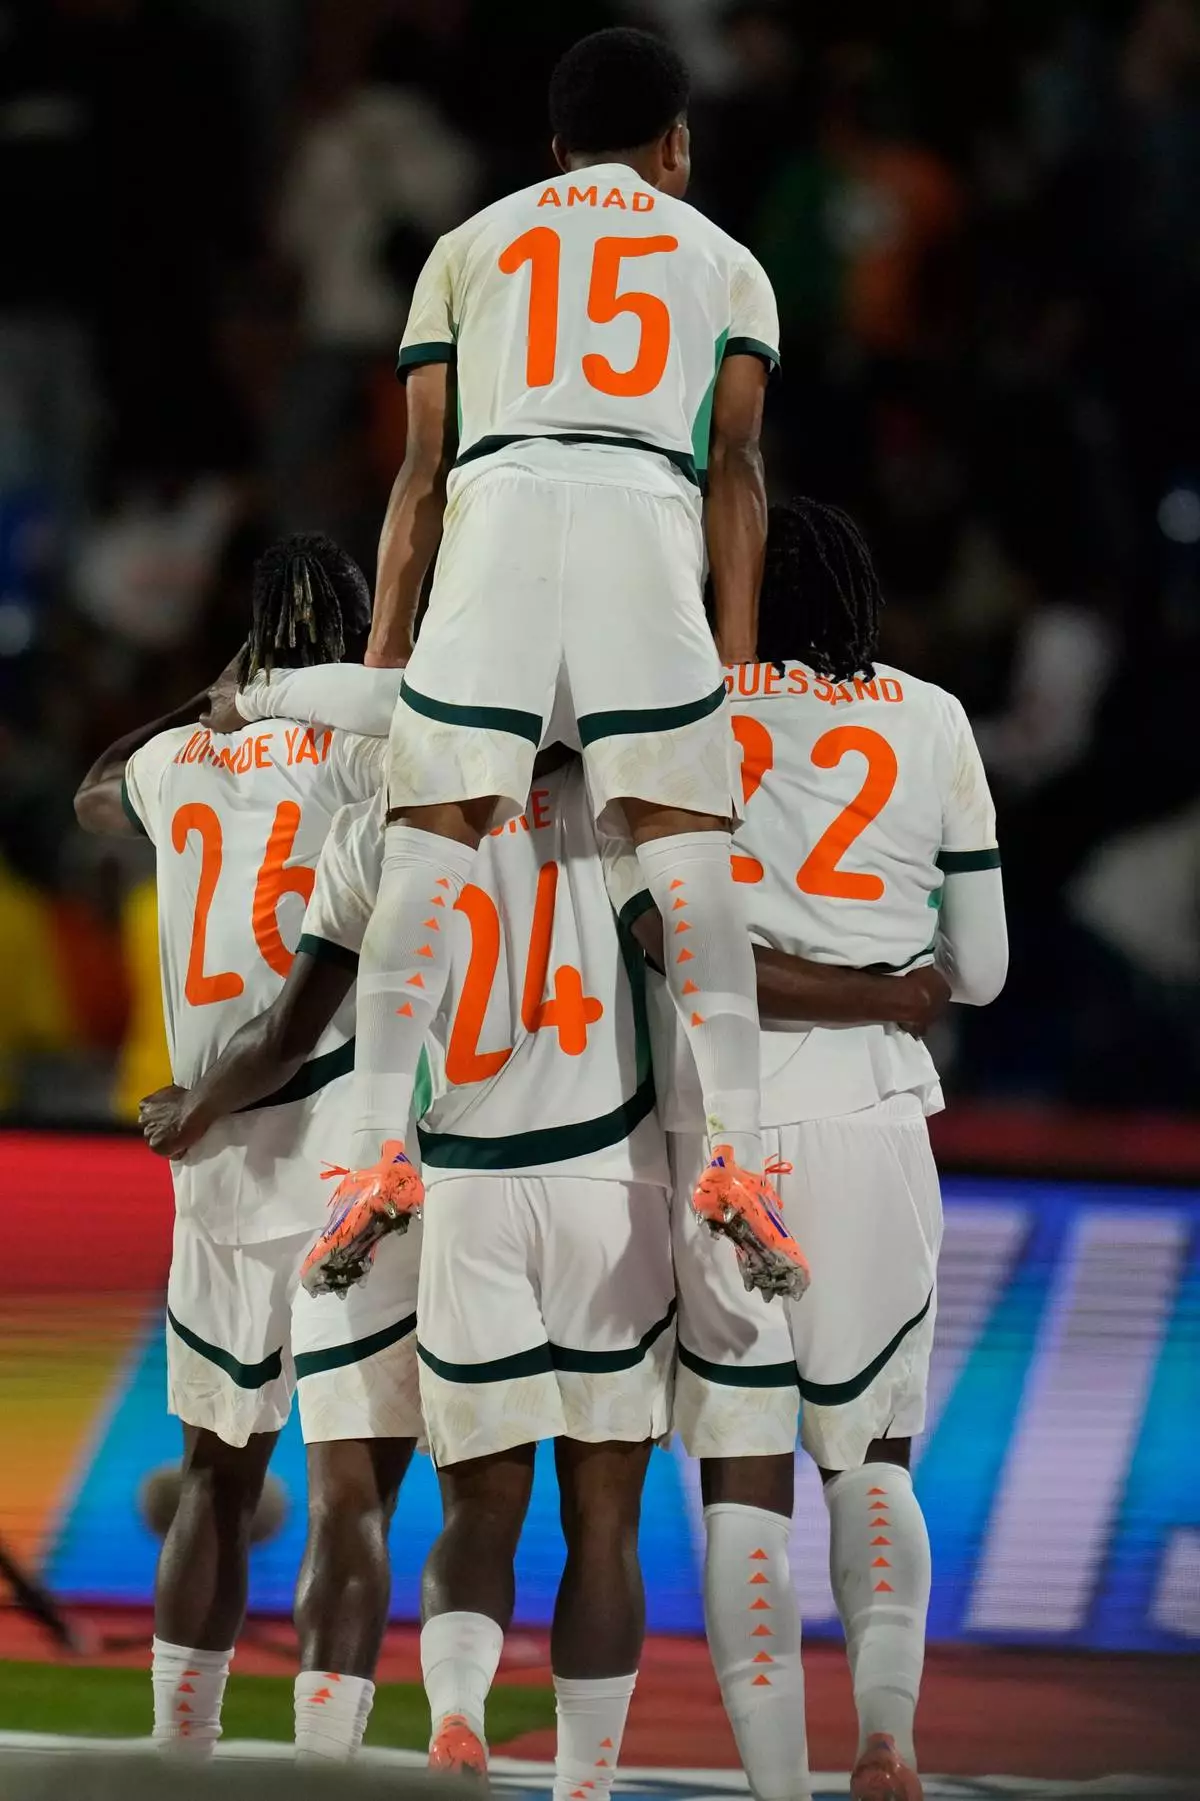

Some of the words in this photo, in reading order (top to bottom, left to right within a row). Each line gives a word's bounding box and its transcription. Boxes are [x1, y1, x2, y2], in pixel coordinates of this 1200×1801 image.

[537, 185, 656, 213] AMAD
[497, 226, 679, 398] 15
[171, 800, 317, 1007] 26
[444, 860, 604, 1086] 24
